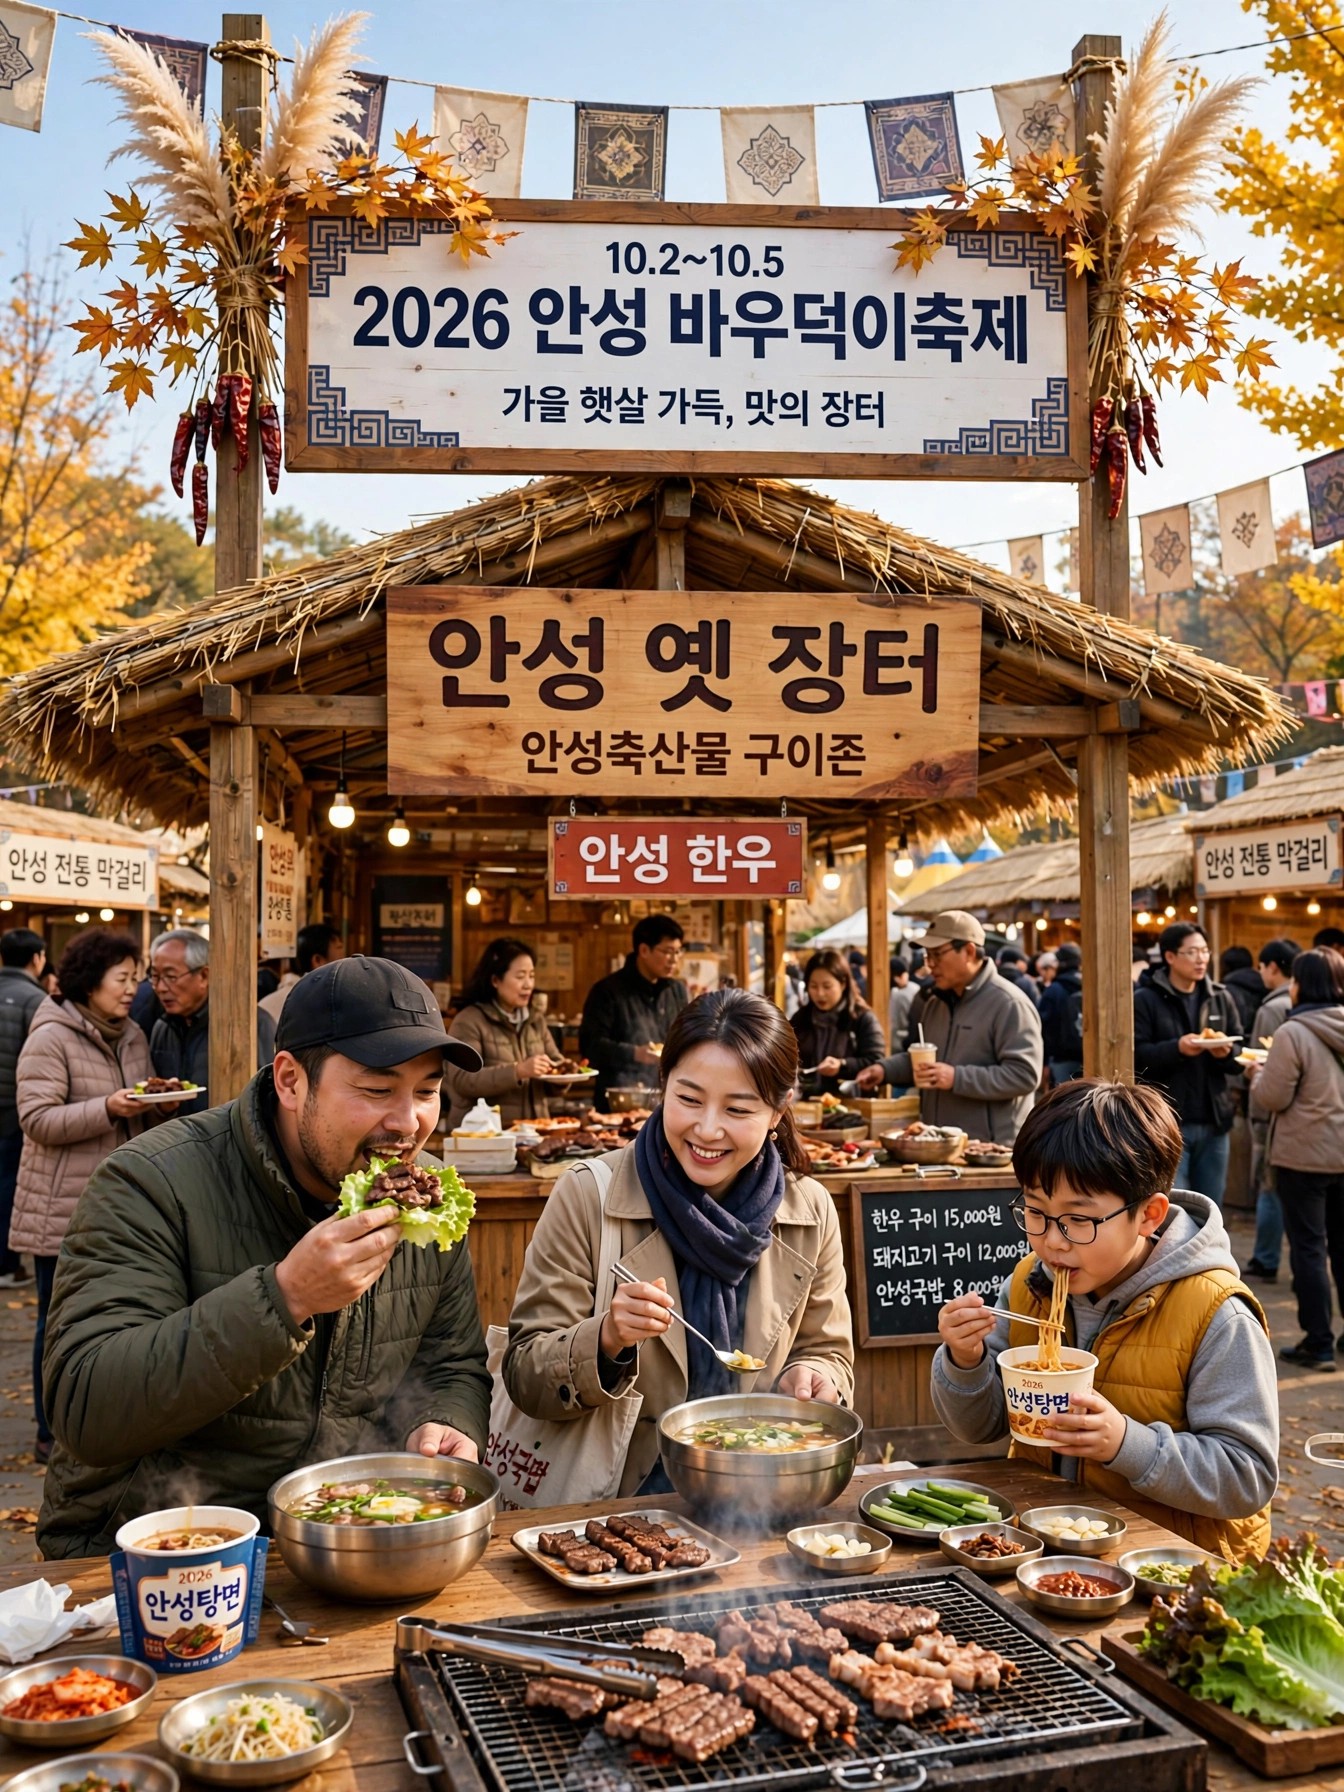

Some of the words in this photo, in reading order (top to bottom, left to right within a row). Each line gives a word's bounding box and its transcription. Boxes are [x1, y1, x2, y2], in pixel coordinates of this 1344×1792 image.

[606, 241, 785, 278] 10.2~10.5
[353, 285, 510, 349] 2026
[528, 285, 647, 357] 안성
[670, 287, 1028, 364] 바우덕이축제
[502, 385, 570, 423] 가을
[580, 386, 649, 424] 햇살
[658, 388, 733, 429] 가득,
[746, 389, 808, 427] 맛의
[820, 390, 885, 429] 장터
[428, 615, 605, 711] 안성
[645, 618, 733, 713] 옛
[768, 621, 940, 714] 장터
[521, 729, 732, 776] 안성축산물
[743, 732, 866, 777] 구이존
[9, 849, 47, 884] 안성
[55, 853, 91, 887] 전통
[97, 857, 146, 892] 막걸리
[579, 834, 669, 884] 안성
[686, 834, 777, 884] 한우
[1205, 846, 1235, 880] 안성
[1240, 842, 1272, 877] 전통
[1276, 835, 1328, 873] 막걸리
[871, 1208, 904, 1233] 한우
[908, 1207, 937, 1231] 구이
[944, 1204, 1003, 1229] 15,000원
[873, 1243, 937, 1270] 돼지고기
[941, 1242, 971, 1266] 구이
[977, 1240, 1031, 1263] 12,000원
[876, 1276, 946, 1307] 안성국밥
[1007, 1387, 1069, 1415] 안성탕면
[1021, 1378, 1044, 1390] 2026
[178, 1568, 213, 1585] 2026
[145, 1577, 241, 1622] 안성탕면
